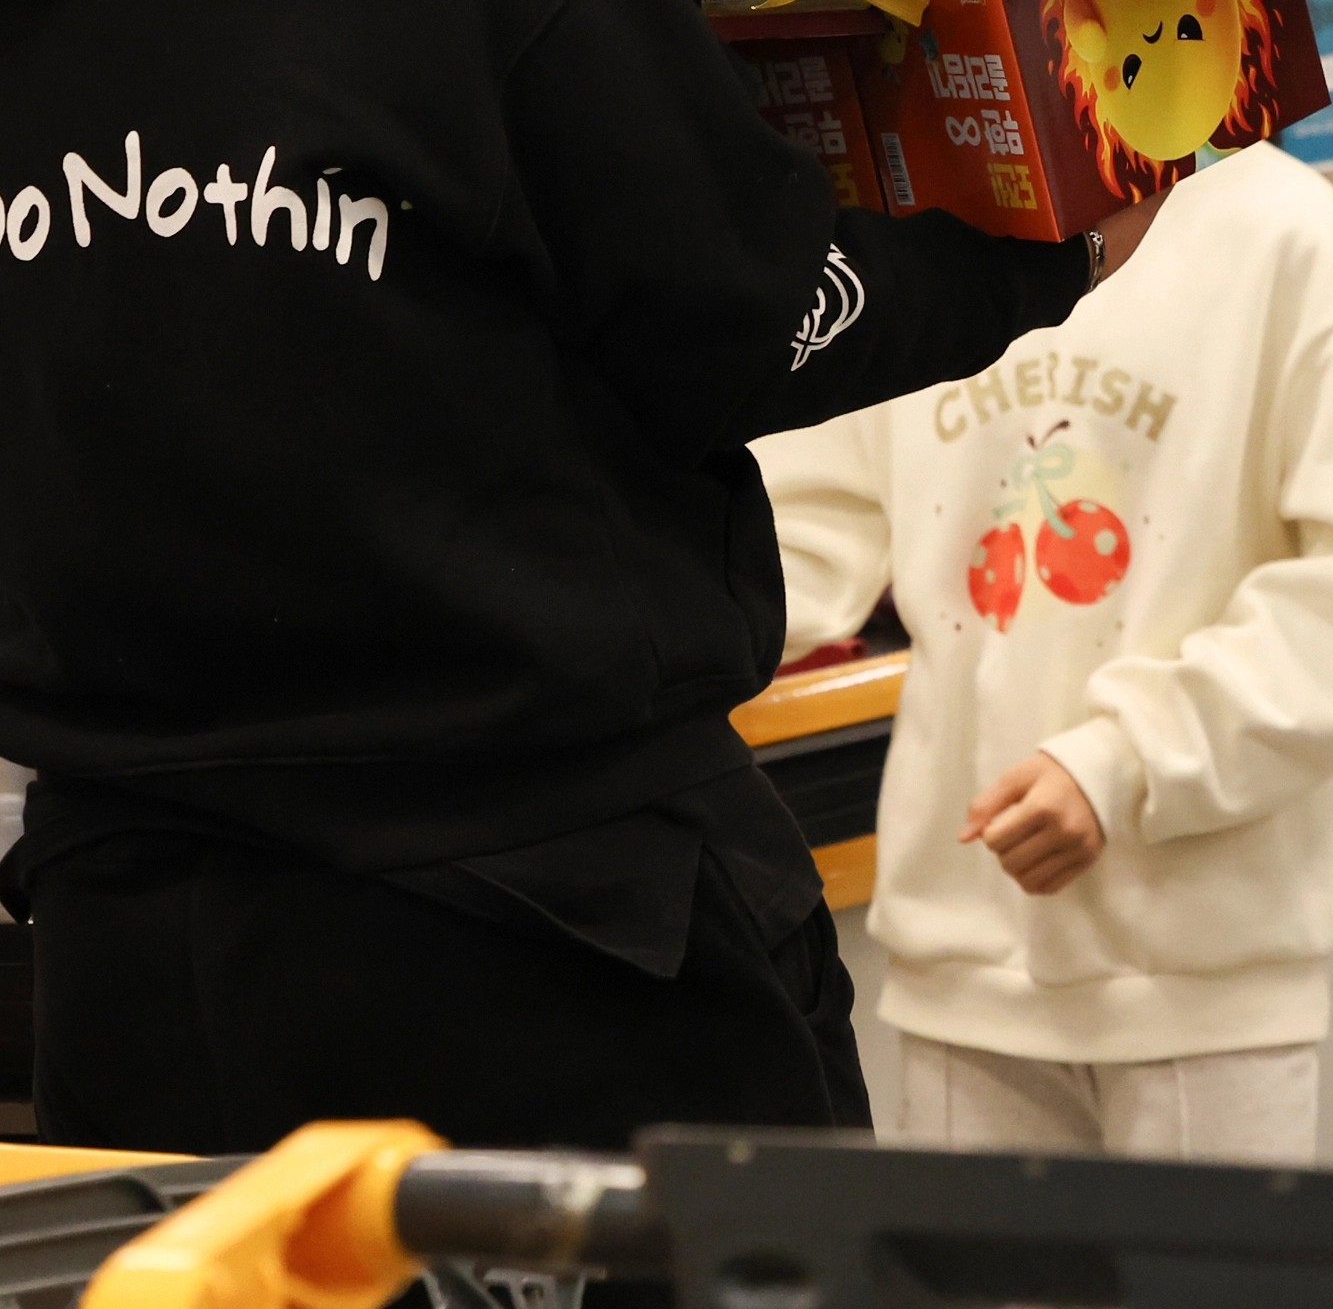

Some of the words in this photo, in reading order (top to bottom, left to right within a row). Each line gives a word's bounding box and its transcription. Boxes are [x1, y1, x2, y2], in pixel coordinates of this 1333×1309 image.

[925, 54, 1011, 102] 골라담기
[0, 185, 51, 262] o
[62, 129, 389, 283] Nothin
[986, 162, 1038, 210] 도전!
